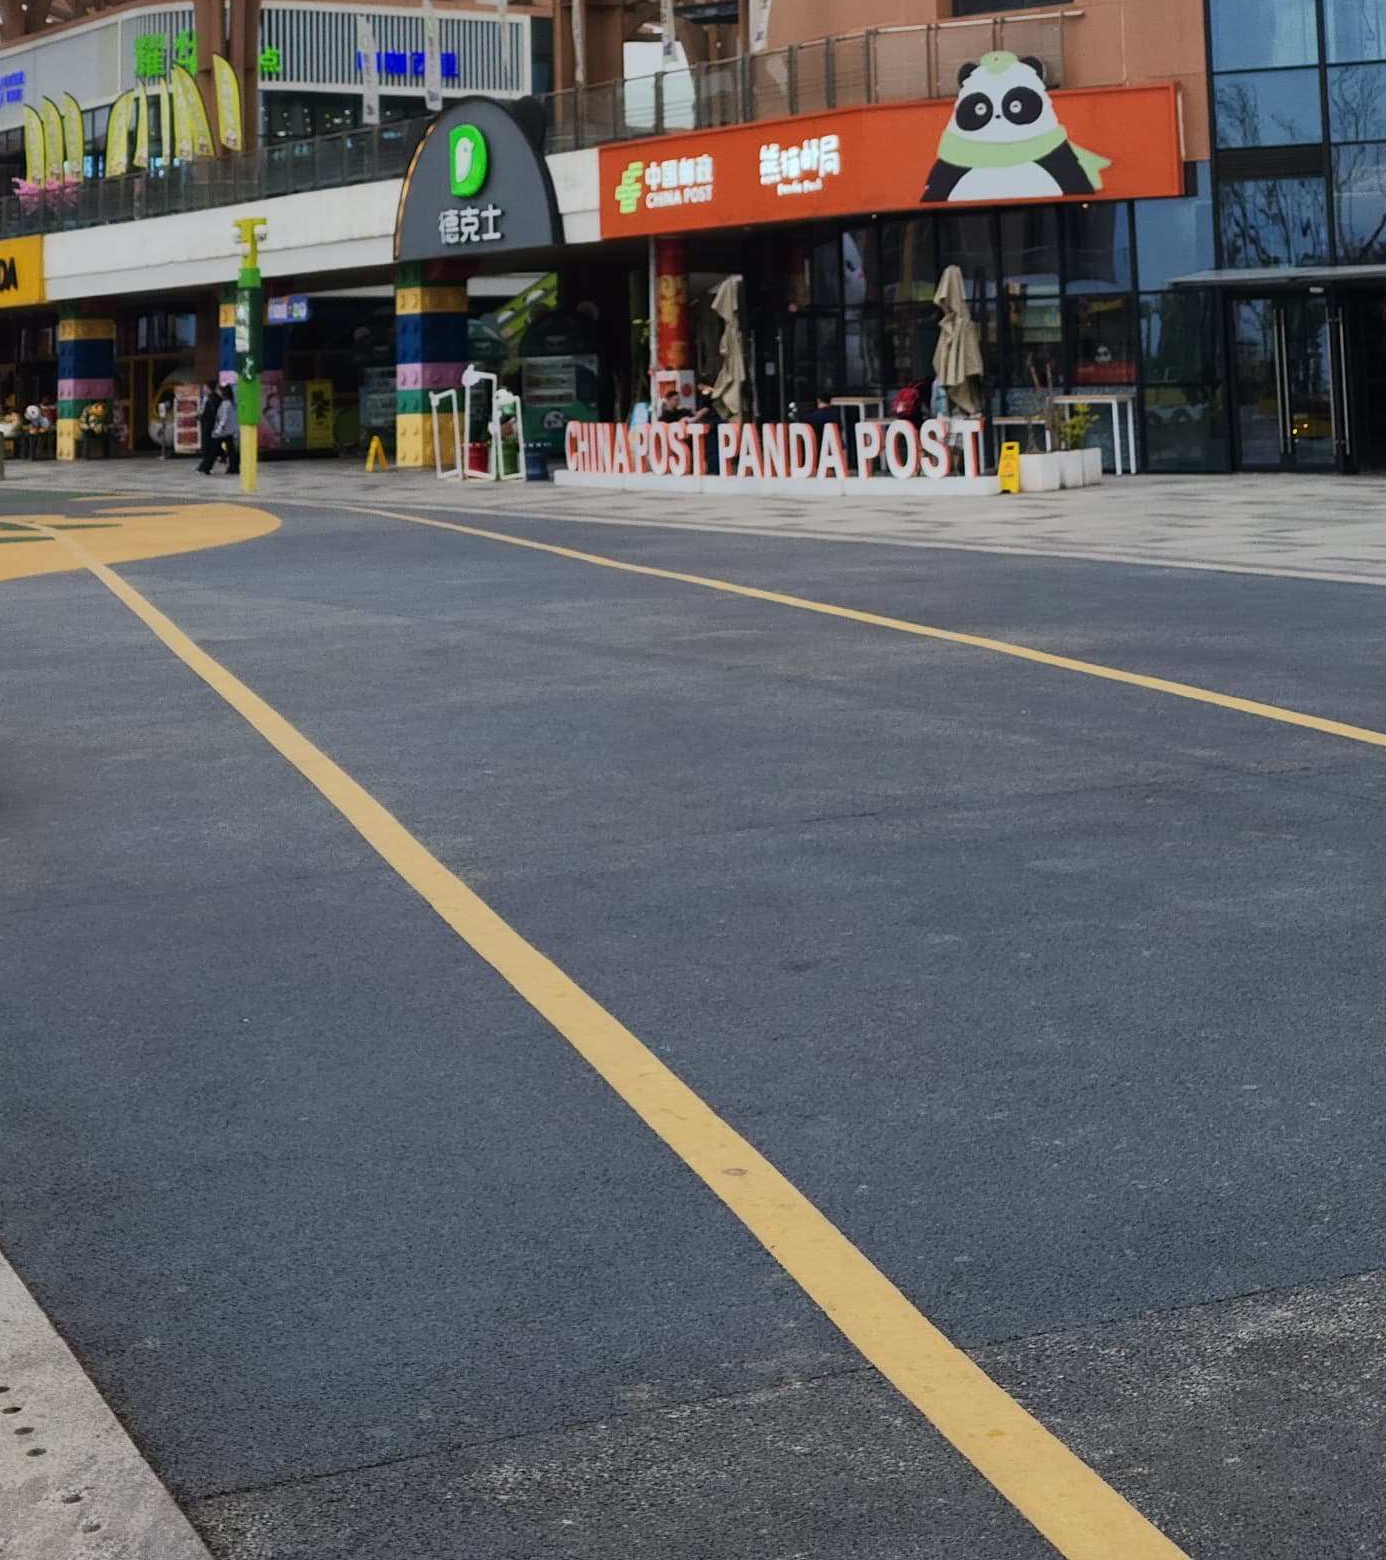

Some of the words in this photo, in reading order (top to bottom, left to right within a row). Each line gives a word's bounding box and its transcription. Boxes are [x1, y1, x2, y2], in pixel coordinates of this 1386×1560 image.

[645, 153, 714, 191] 中国邮政
[759, 134, 841, 185] 熊猫邮局
[645, 189, 683, 209] CHINA
[683, 184, 714, 204] POST
[438, 204, 502, 244] 德克士
[566, 421, 633, 474] CHINA
[633, 421, 709, 476] POST
[718, 422, 850, 480] PANDA
[855, 419, 987, 480] POST
